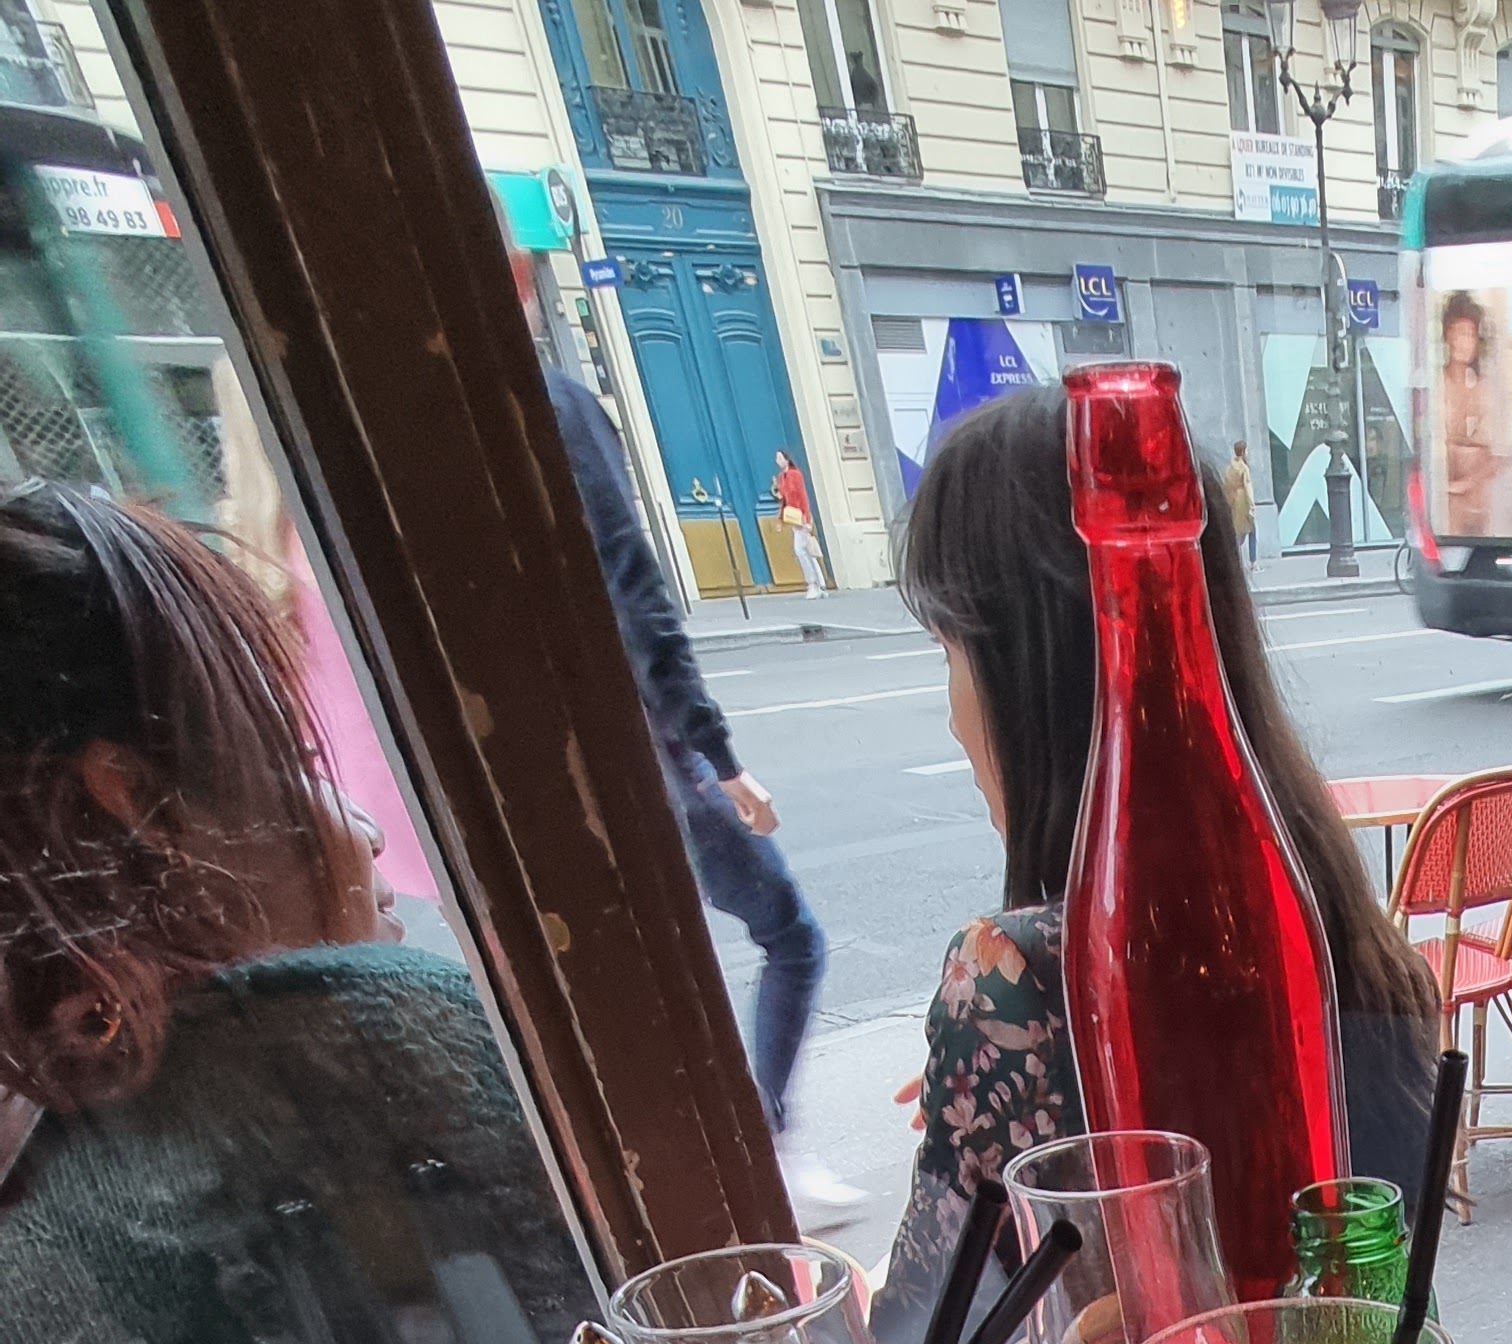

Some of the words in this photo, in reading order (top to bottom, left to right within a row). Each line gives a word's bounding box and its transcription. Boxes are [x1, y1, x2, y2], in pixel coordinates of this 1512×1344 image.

[66, 206, 91, 226] 98
[96, 209, 120, 229] 49
[124, 211, 148, 230] 83
[661, 206, 684, 230] 20
[1080, 277, 1112, 296] LCL
[1351, 290, 1375, 307] LCL
[1000, 355, 1018, 368] LCL
[991, 372, 1033, 385] EXPRESS
